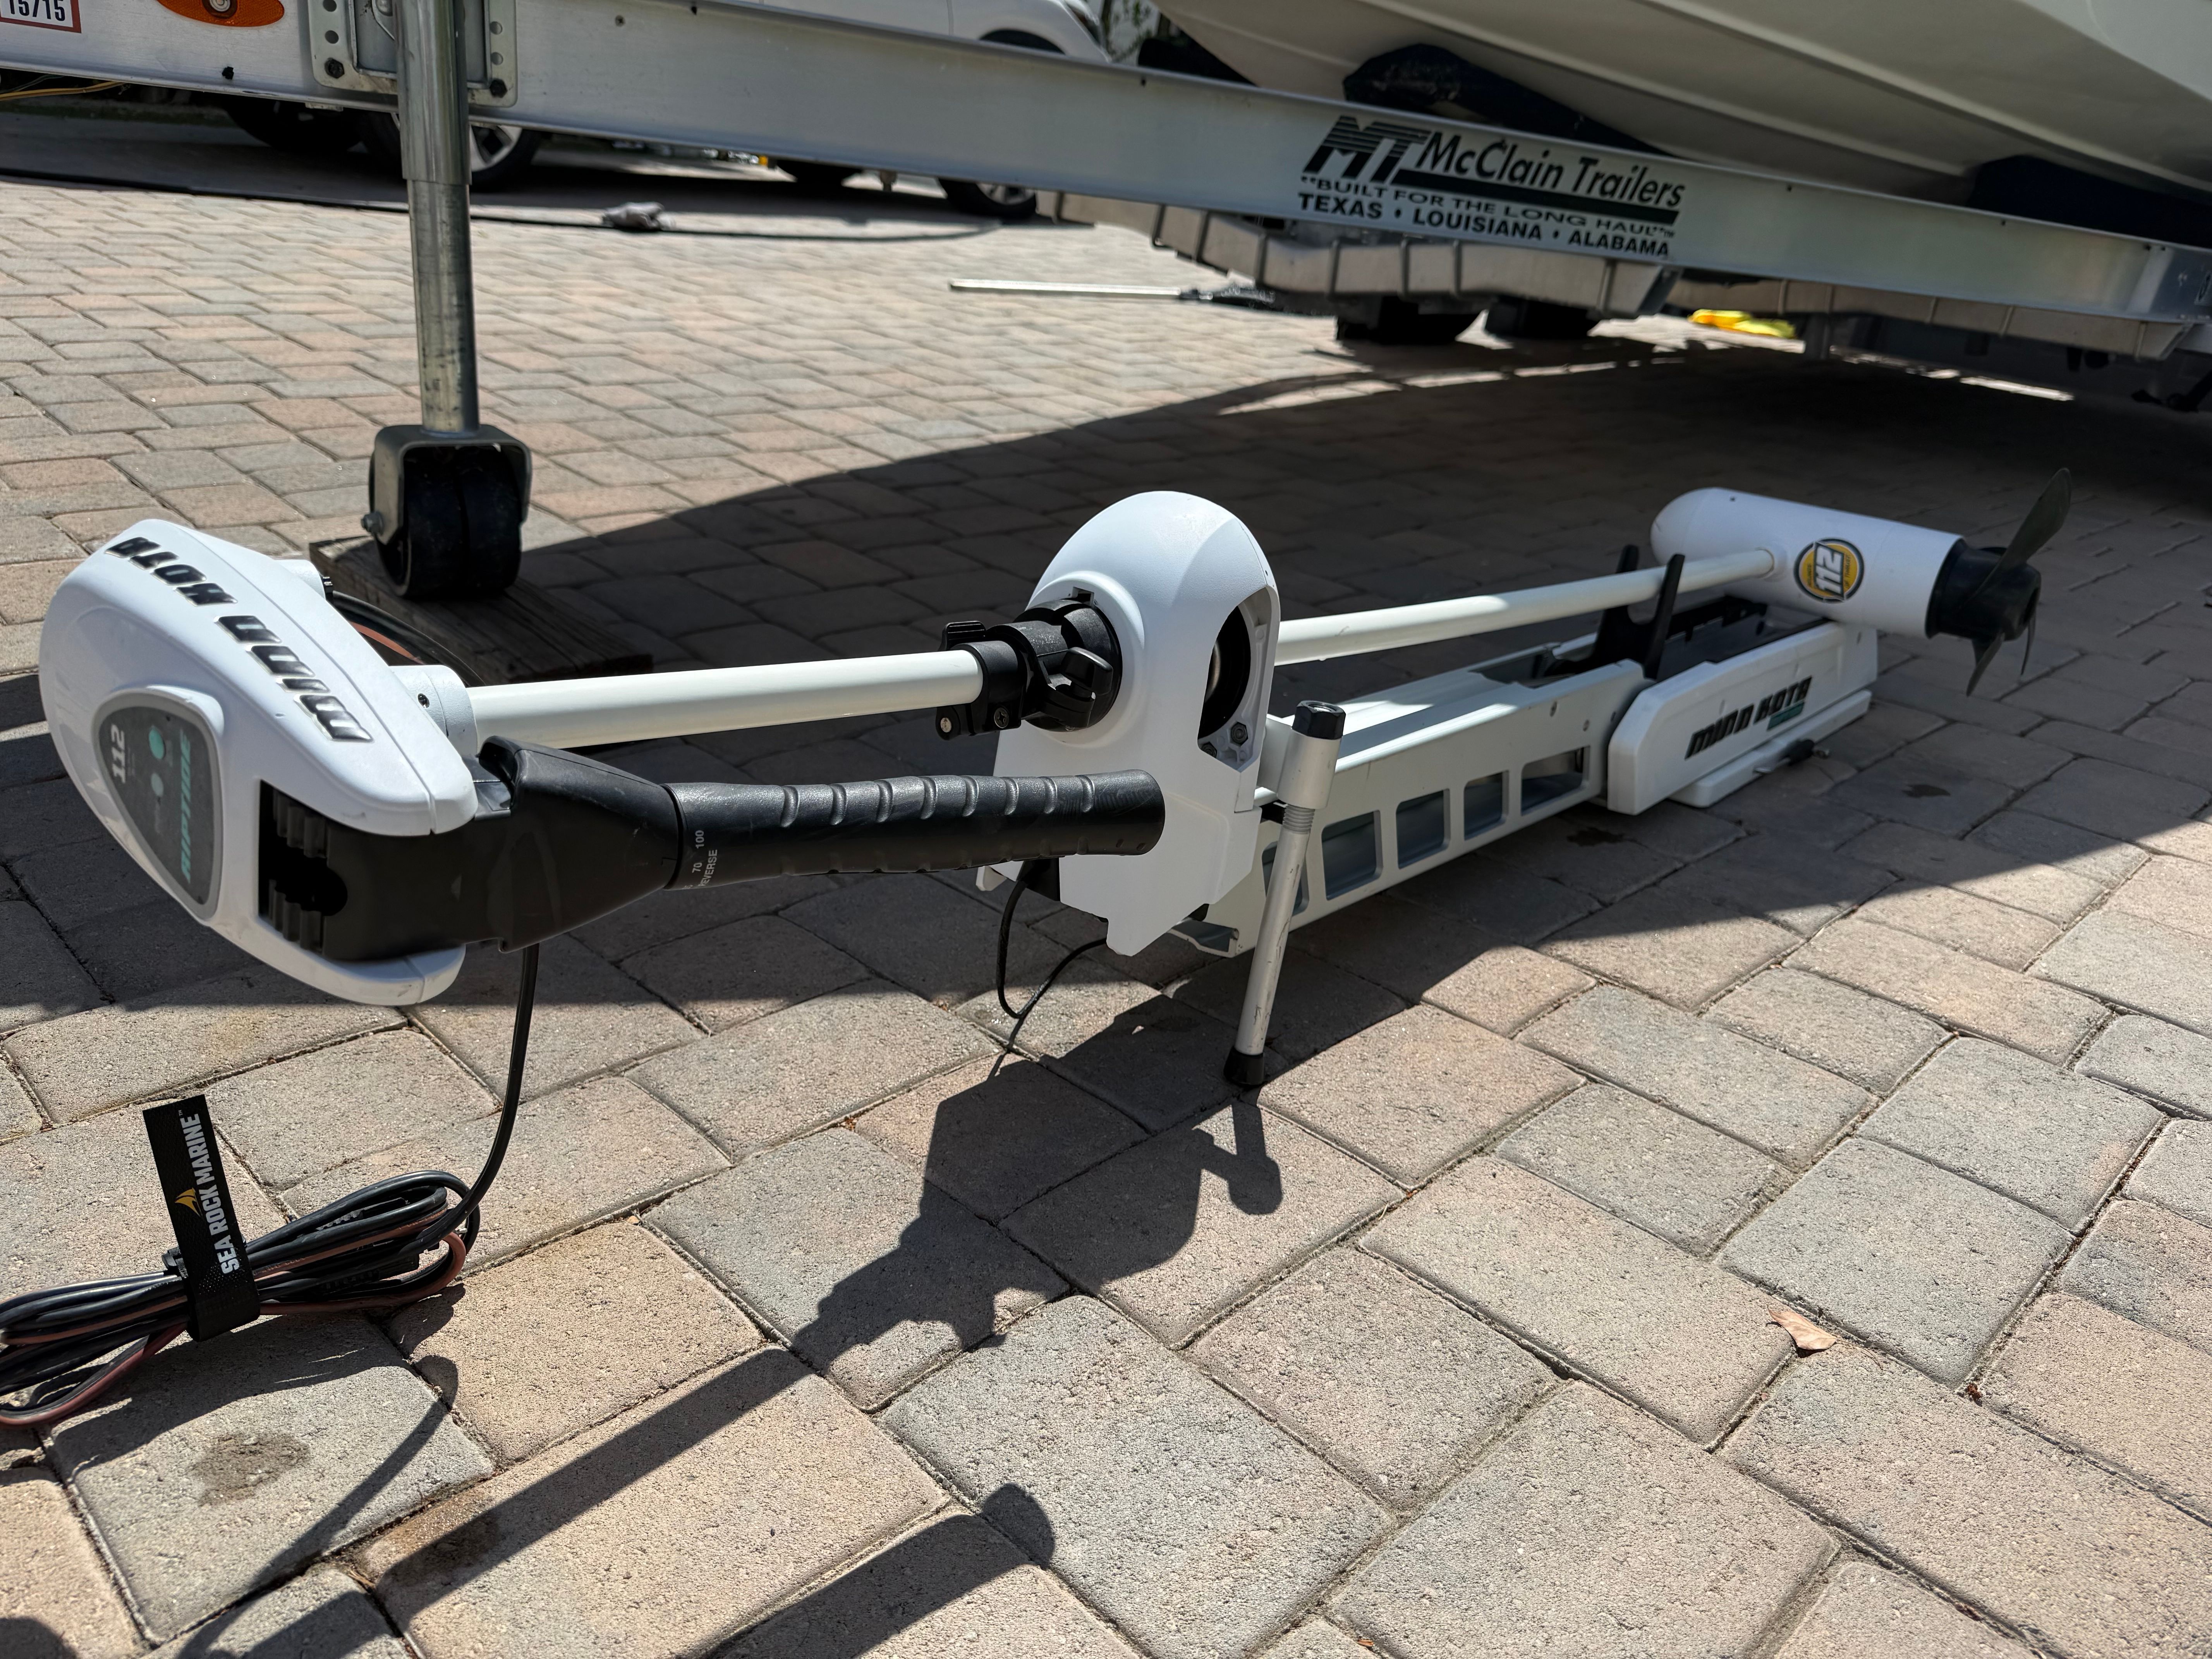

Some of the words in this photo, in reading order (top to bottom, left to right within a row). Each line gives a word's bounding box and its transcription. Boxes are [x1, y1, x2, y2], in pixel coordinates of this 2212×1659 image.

[1415, 131, 1564, 189] McClain
[1572, 156, 1685, 207] Trailers
[1298, 193, 1382, 220] TEXAS
[1412, 208, 1542, 241] LOUISIANA
[1568, 230, 1669, 256] ALABAMA
[1395, 190, 1444, 207] FOR
[1452, 198, 1496, 214] THE
[1504, 206, 1586, 227] LONG
[1815, 546, 1842, 594] 112
[111, 723, 126, 785] 112
[180, 727, 191, 884] RIPTIDE
[695, 830, 705, 849] 100
[692, 862, 702, 873] 70
[698, 849, 718, 887] REVERSE
[180, 1113, 215, 1185] MARINE
[198, 1184, 228, 1236] ROCK
[214, 1234, 240, 1274] SEA
